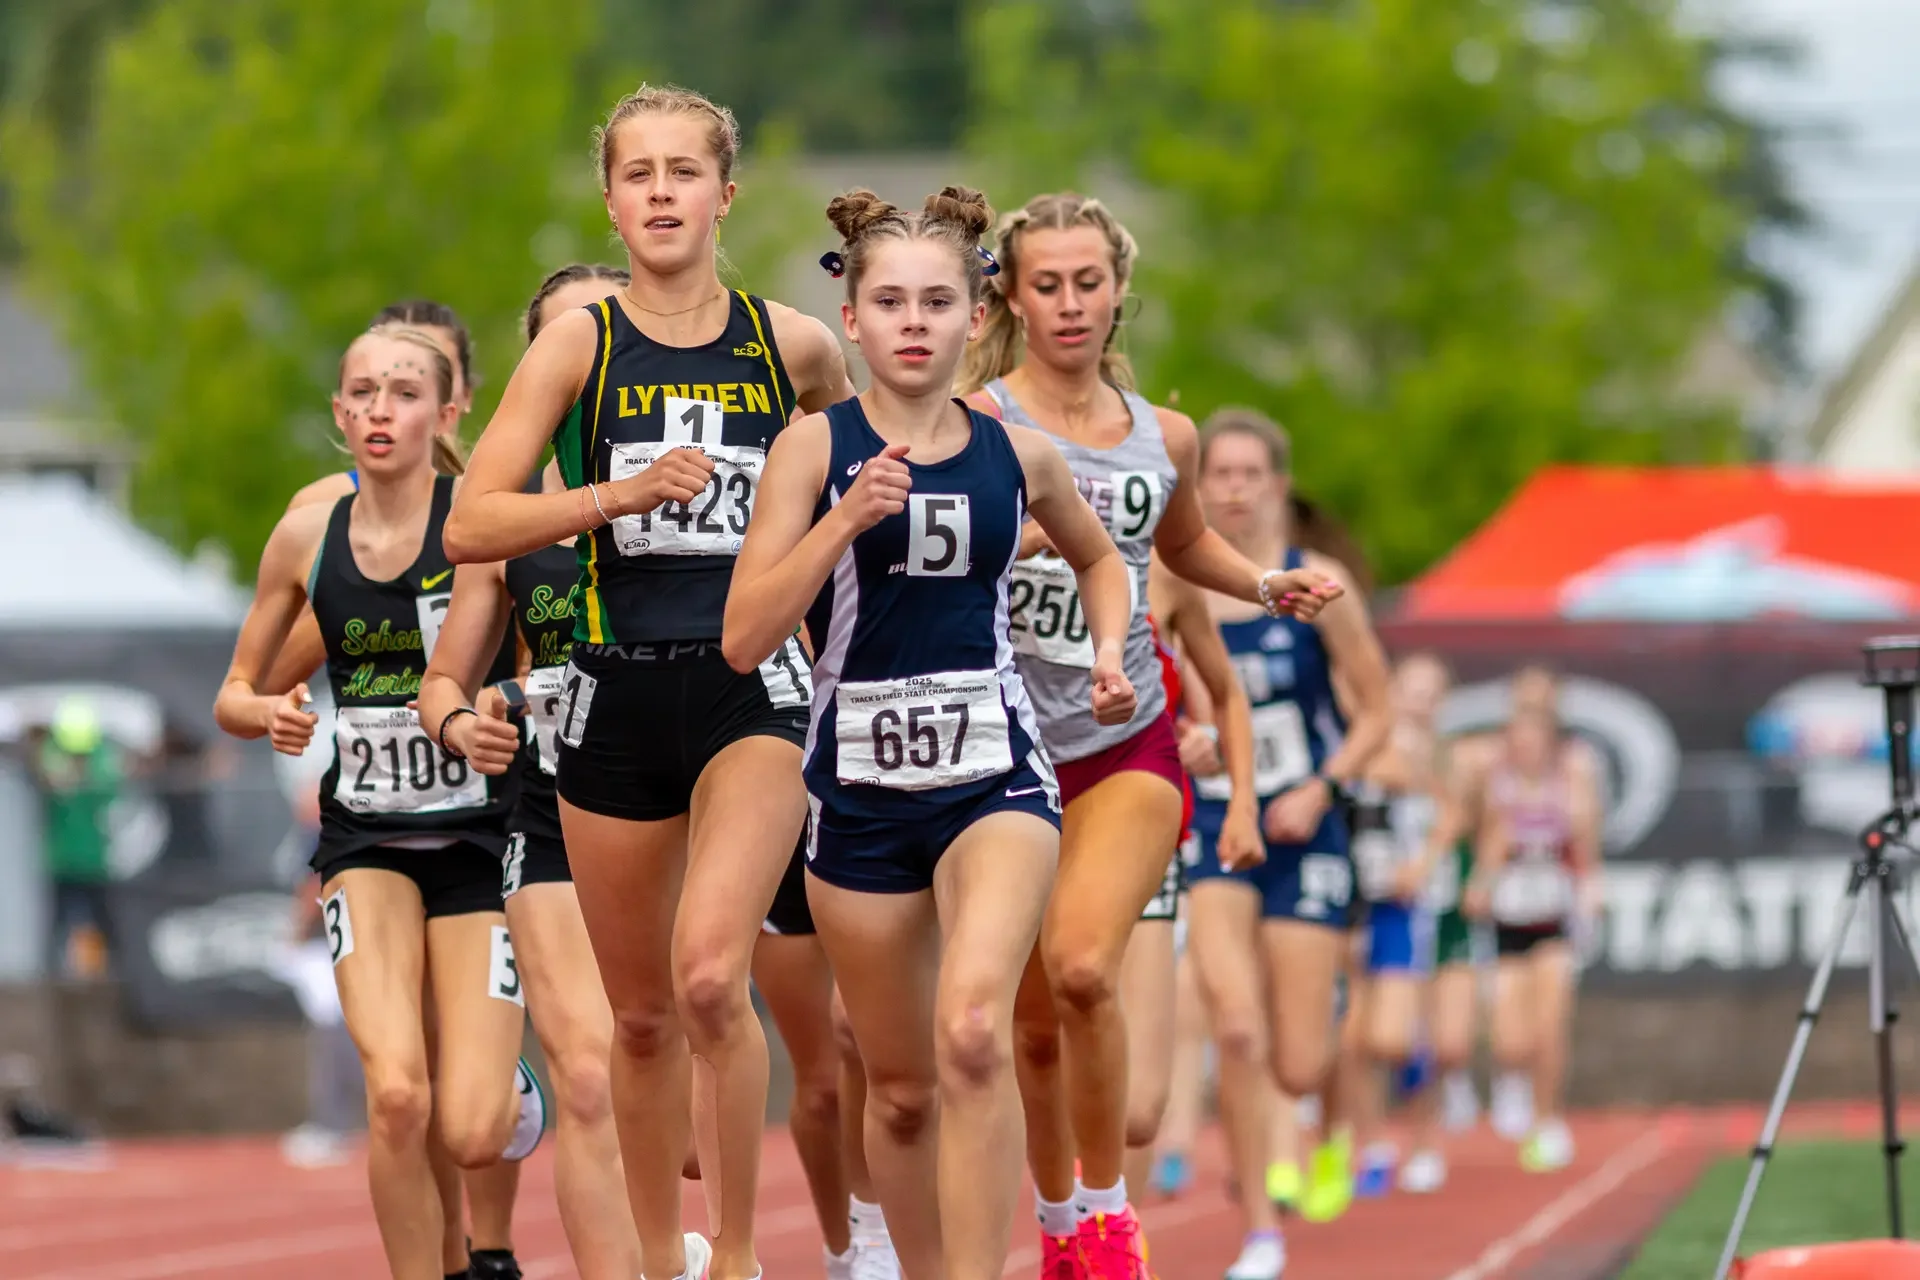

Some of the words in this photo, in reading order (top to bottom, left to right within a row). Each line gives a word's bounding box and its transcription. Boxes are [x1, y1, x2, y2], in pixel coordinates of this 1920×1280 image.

[733, 347, 754, 356] PCS
[680, 404, 704, 444] 1
[922, 498, 957, 572] 5
[1122, 475, 1151, 537] 9
[772, 649, 809, 702] 1
[882, 691, 903, 700] FIELD
[904, 690, 927, 698] STATE
[928, 684, 988, 696] CHAMPIONSHIPS
[905, 677, 933, 686] 2025
[562, 674, 582, 739] 1
[351, 734, 468, 792] 2108
[871, 703, 969, 770] 657
[326, 898, 343, 961] 3
